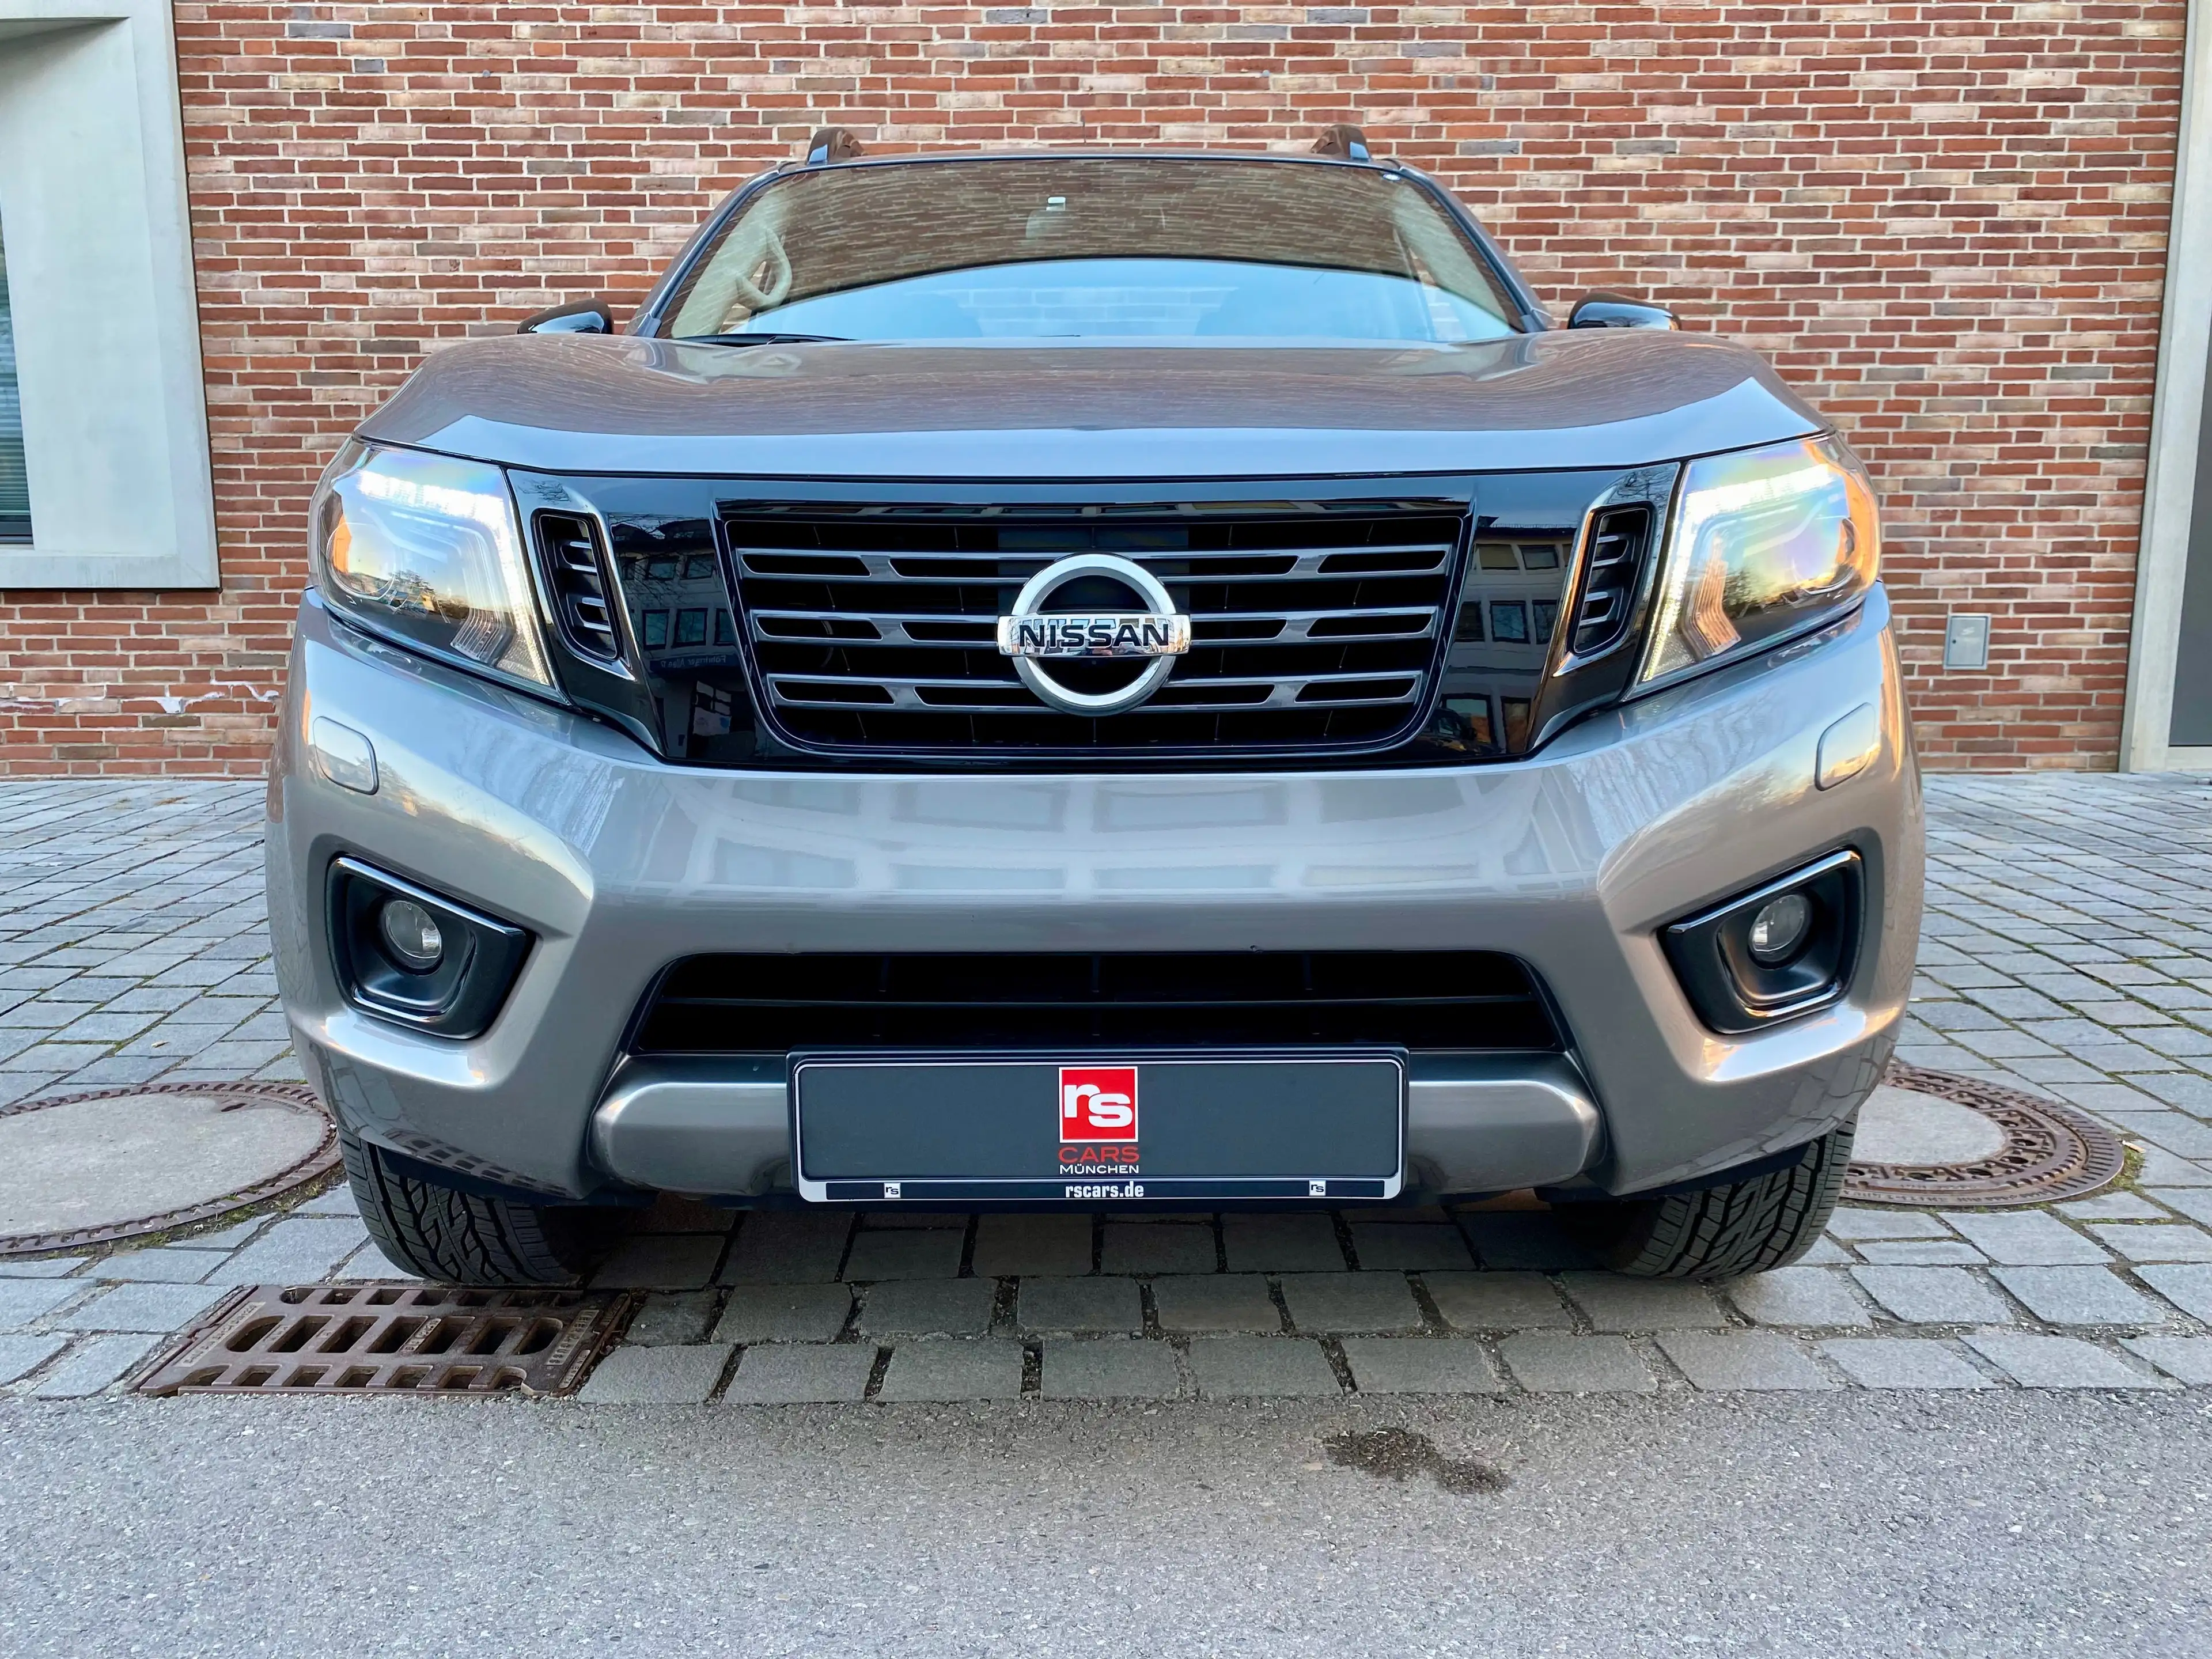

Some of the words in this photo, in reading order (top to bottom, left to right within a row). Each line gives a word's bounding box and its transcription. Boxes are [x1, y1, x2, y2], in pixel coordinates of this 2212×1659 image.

[1019, 624, 1169, 647] NISSAN
[1064, 1084, 1133, 1127] rs
[1058, 1146, 1139, 1163] CARS
[1059, 1164, 1139, 1175] MÜNCHEN
[1065, 1181, 1144, 1198] rscars.de
[1311, 1184, 1324, 1192] rs
